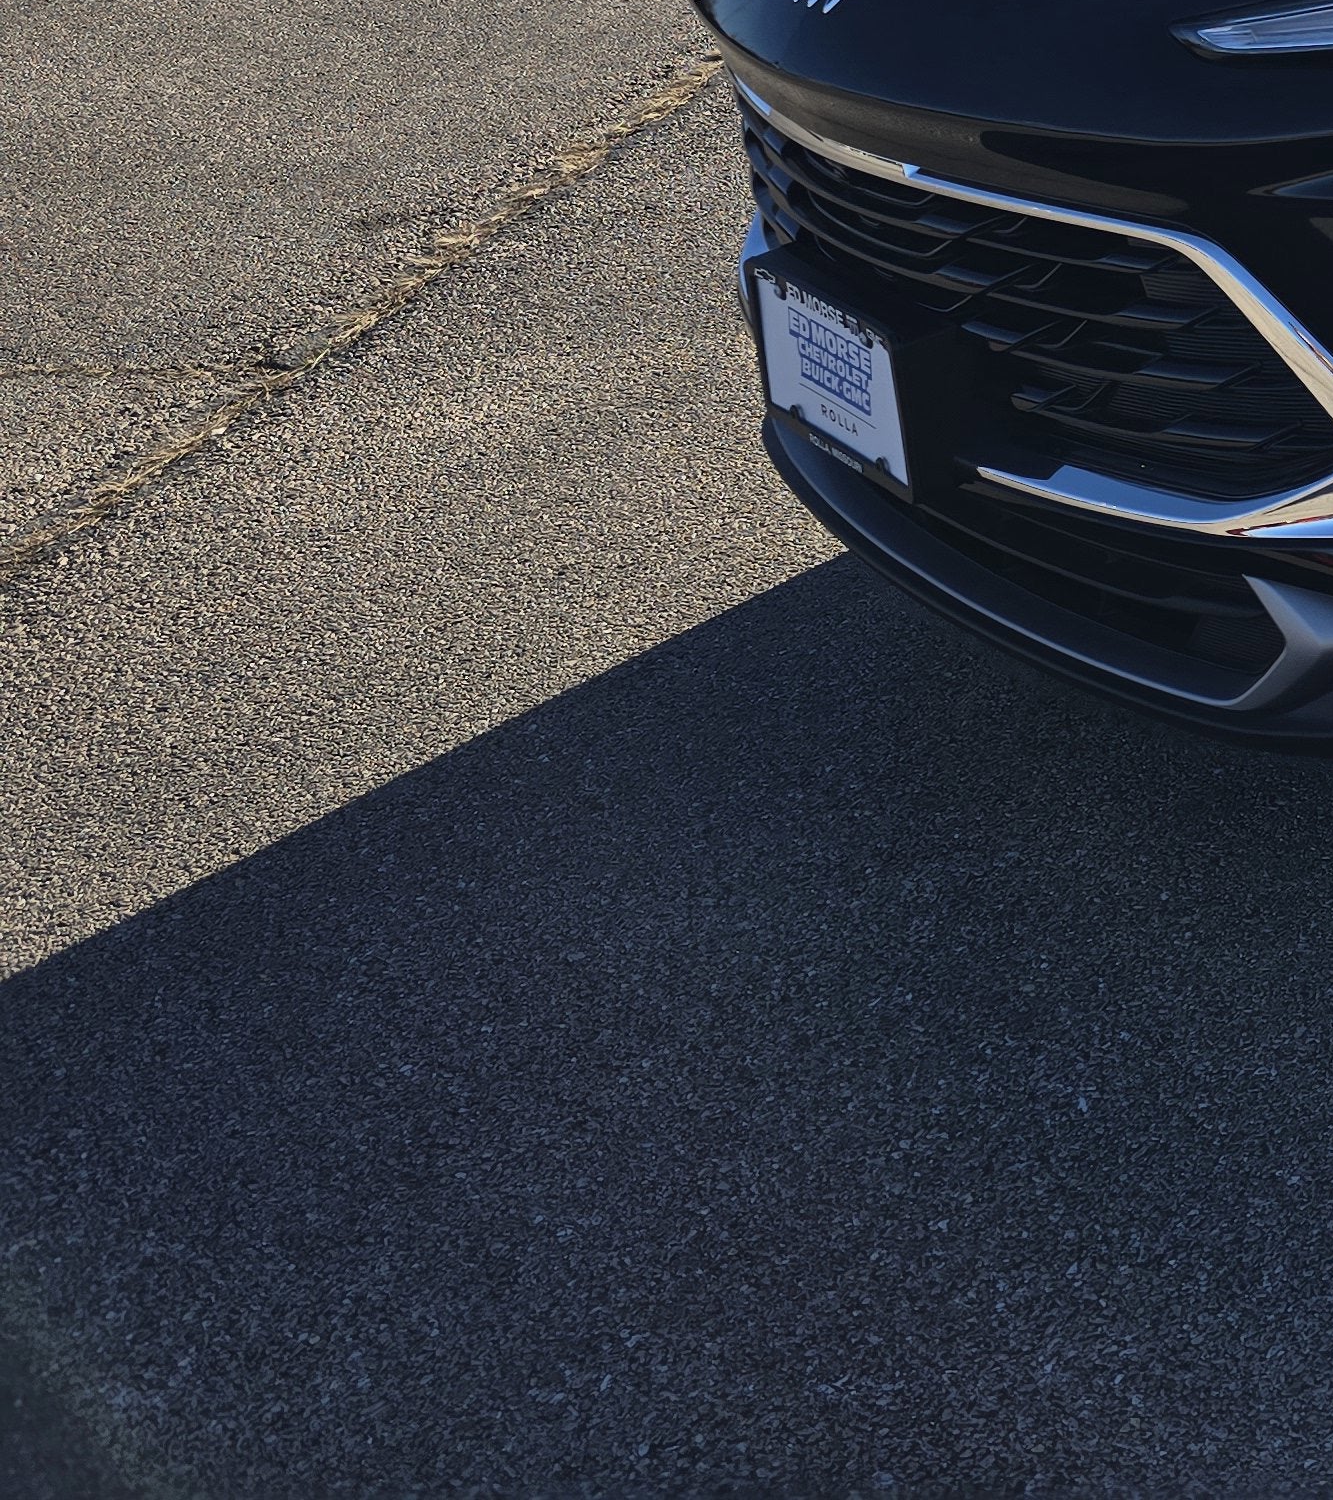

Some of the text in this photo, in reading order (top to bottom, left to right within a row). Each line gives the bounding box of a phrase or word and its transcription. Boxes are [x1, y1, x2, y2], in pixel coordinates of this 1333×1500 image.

[786, 281, 844, 324] ED MORSE
[788, 307, 872, 374] ED MORSE
[798, 338, 871, 390] CHEVROLET
[820, 404, 859, 436] ROLLA
